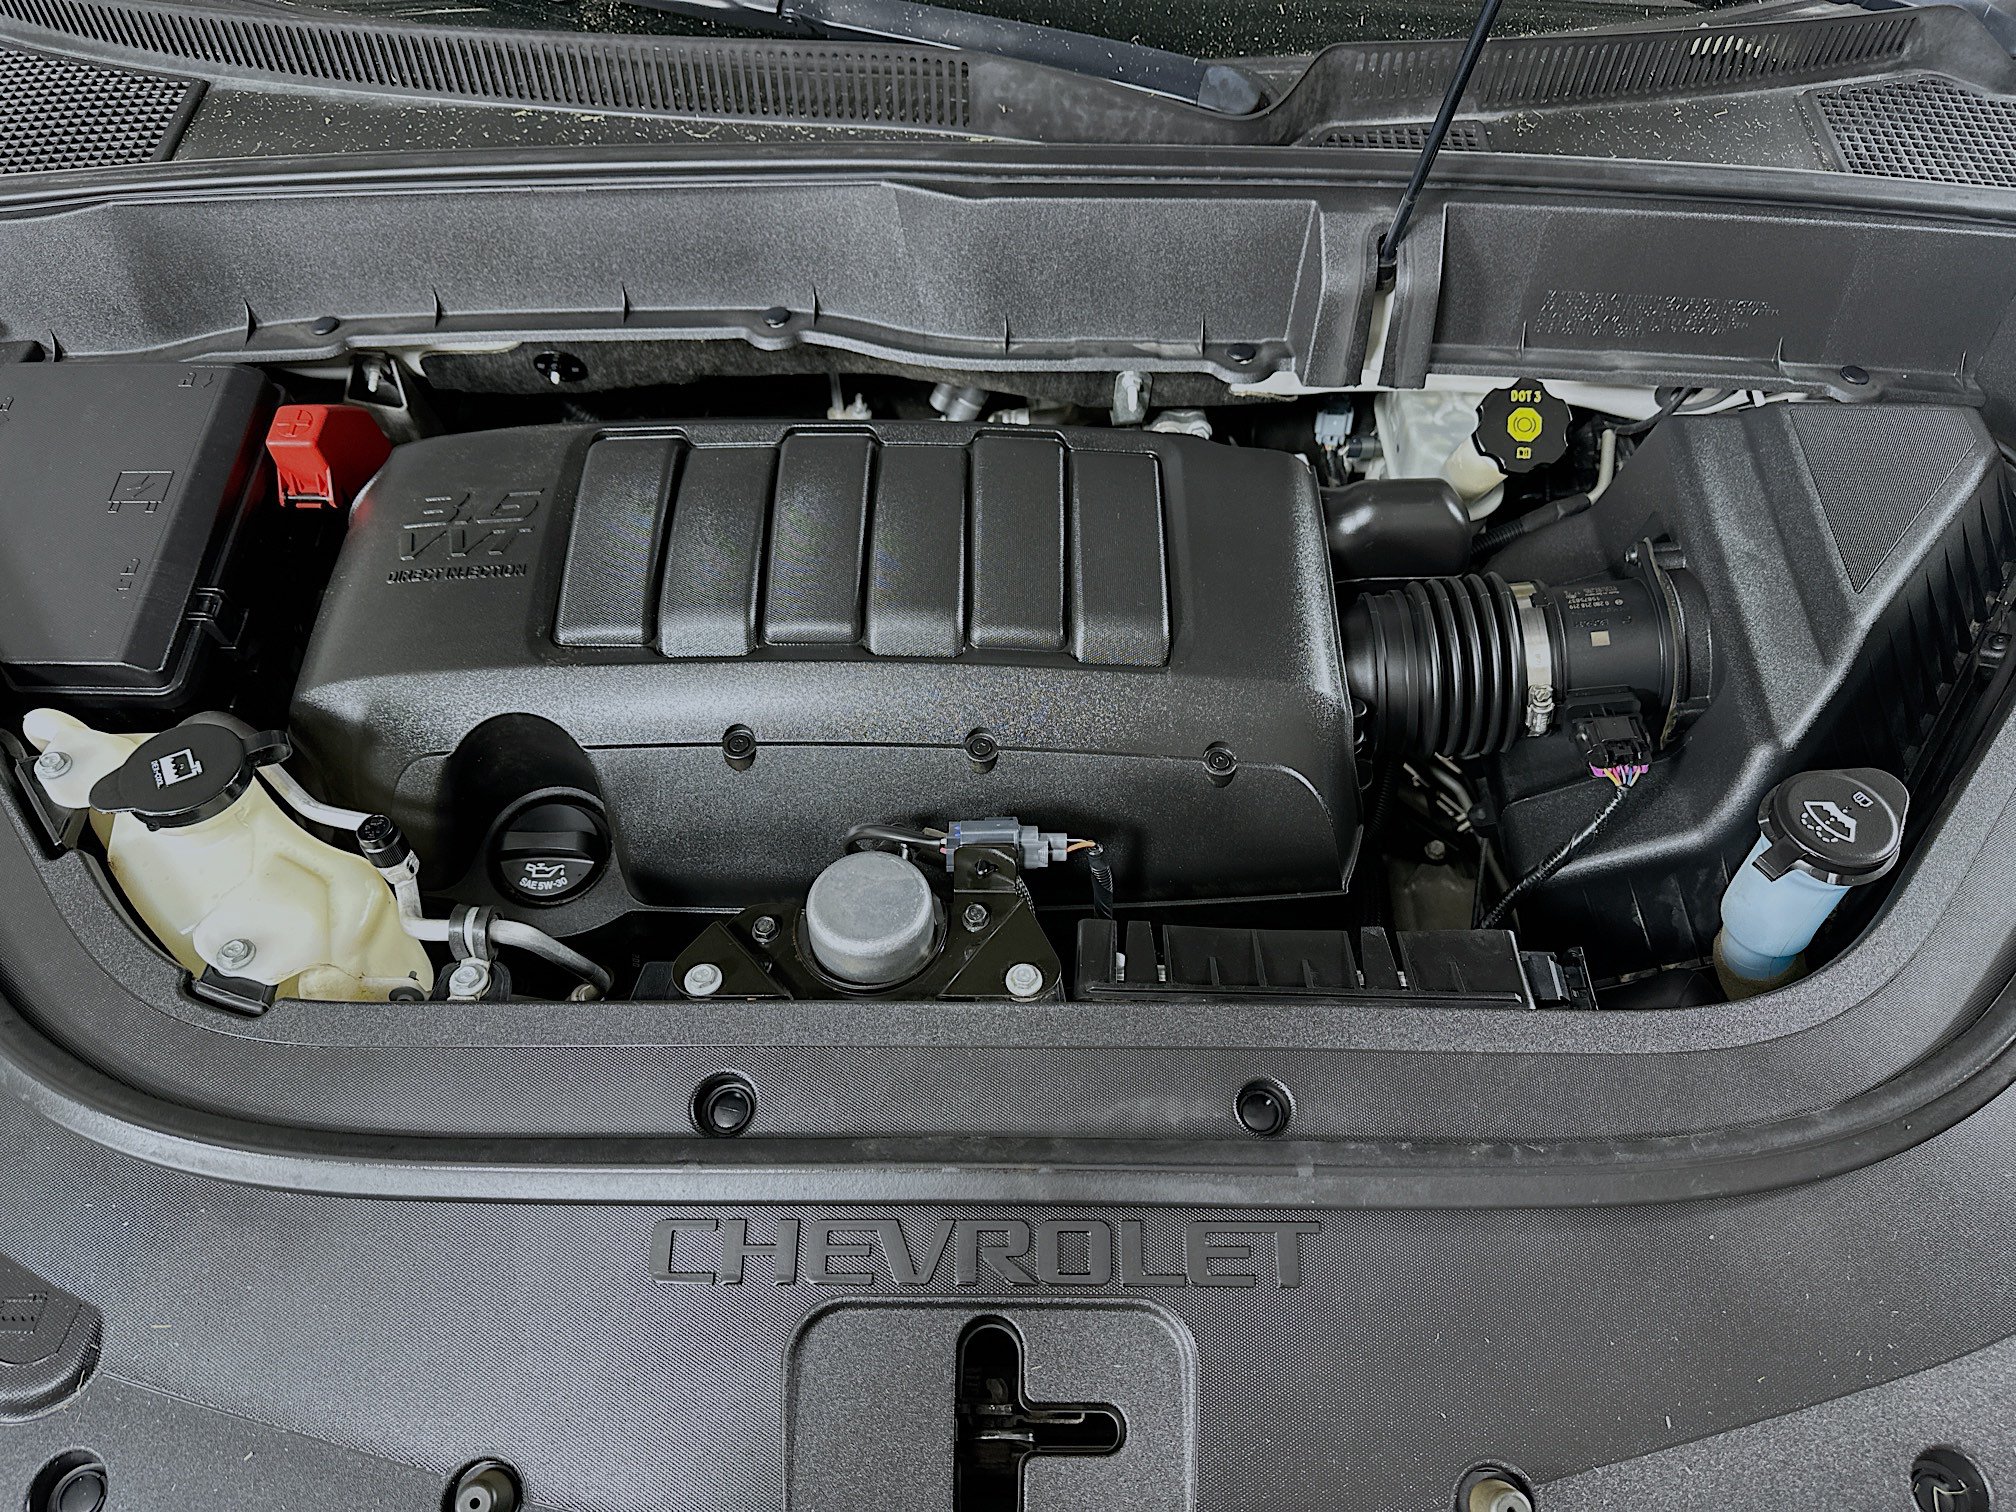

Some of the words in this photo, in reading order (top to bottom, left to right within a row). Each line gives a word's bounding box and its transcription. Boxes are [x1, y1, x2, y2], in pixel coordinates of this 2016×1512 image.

[1510, 389, 1533, 403] DOT
[1533, 390, 1542, 403] 3
[402, 487, 546, 529] 3.6
[400, 527, 536, 561] VVT
[386, 568, 443, 584] DIRECT
[443, 563, 528, 581] INJECTION
[519, 877, 537, 890] SAE
[537, 876, 568, 890] 5W-30
[650, 1218, 1322, 1288] CHEVROLET
